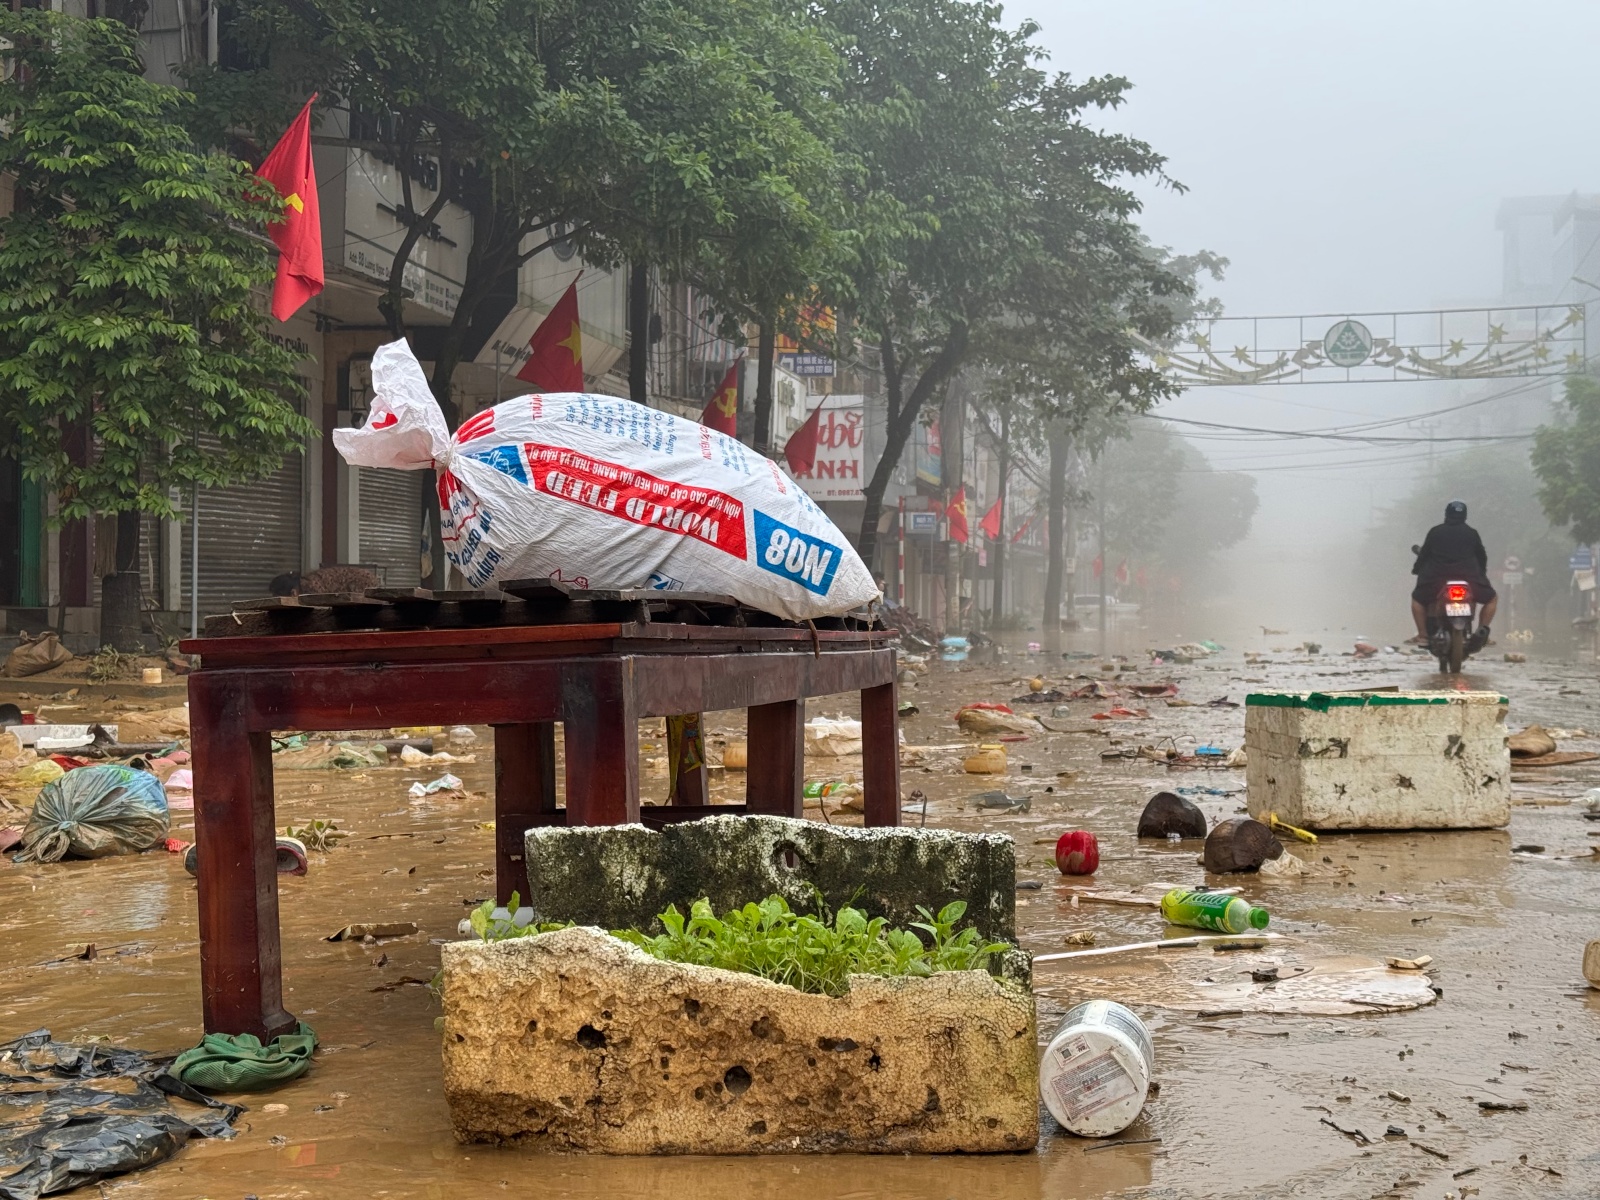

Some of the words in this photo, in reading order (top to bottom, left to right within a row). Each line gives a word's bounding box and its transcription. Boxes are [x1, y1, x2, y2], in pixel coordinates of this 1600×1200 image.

[529, 445, 539, 460] BỊ
[571, 456, 591, 472] THAI
[592, 463, 618, 480] MANG
[634, 475, 651, 491] HEO
[652, 482, 670, 497] CHO
[546, 471, 620, 513] FEED
[690, 490, 708, 505] CAO
[625, 497, 720, 544] WORLD
